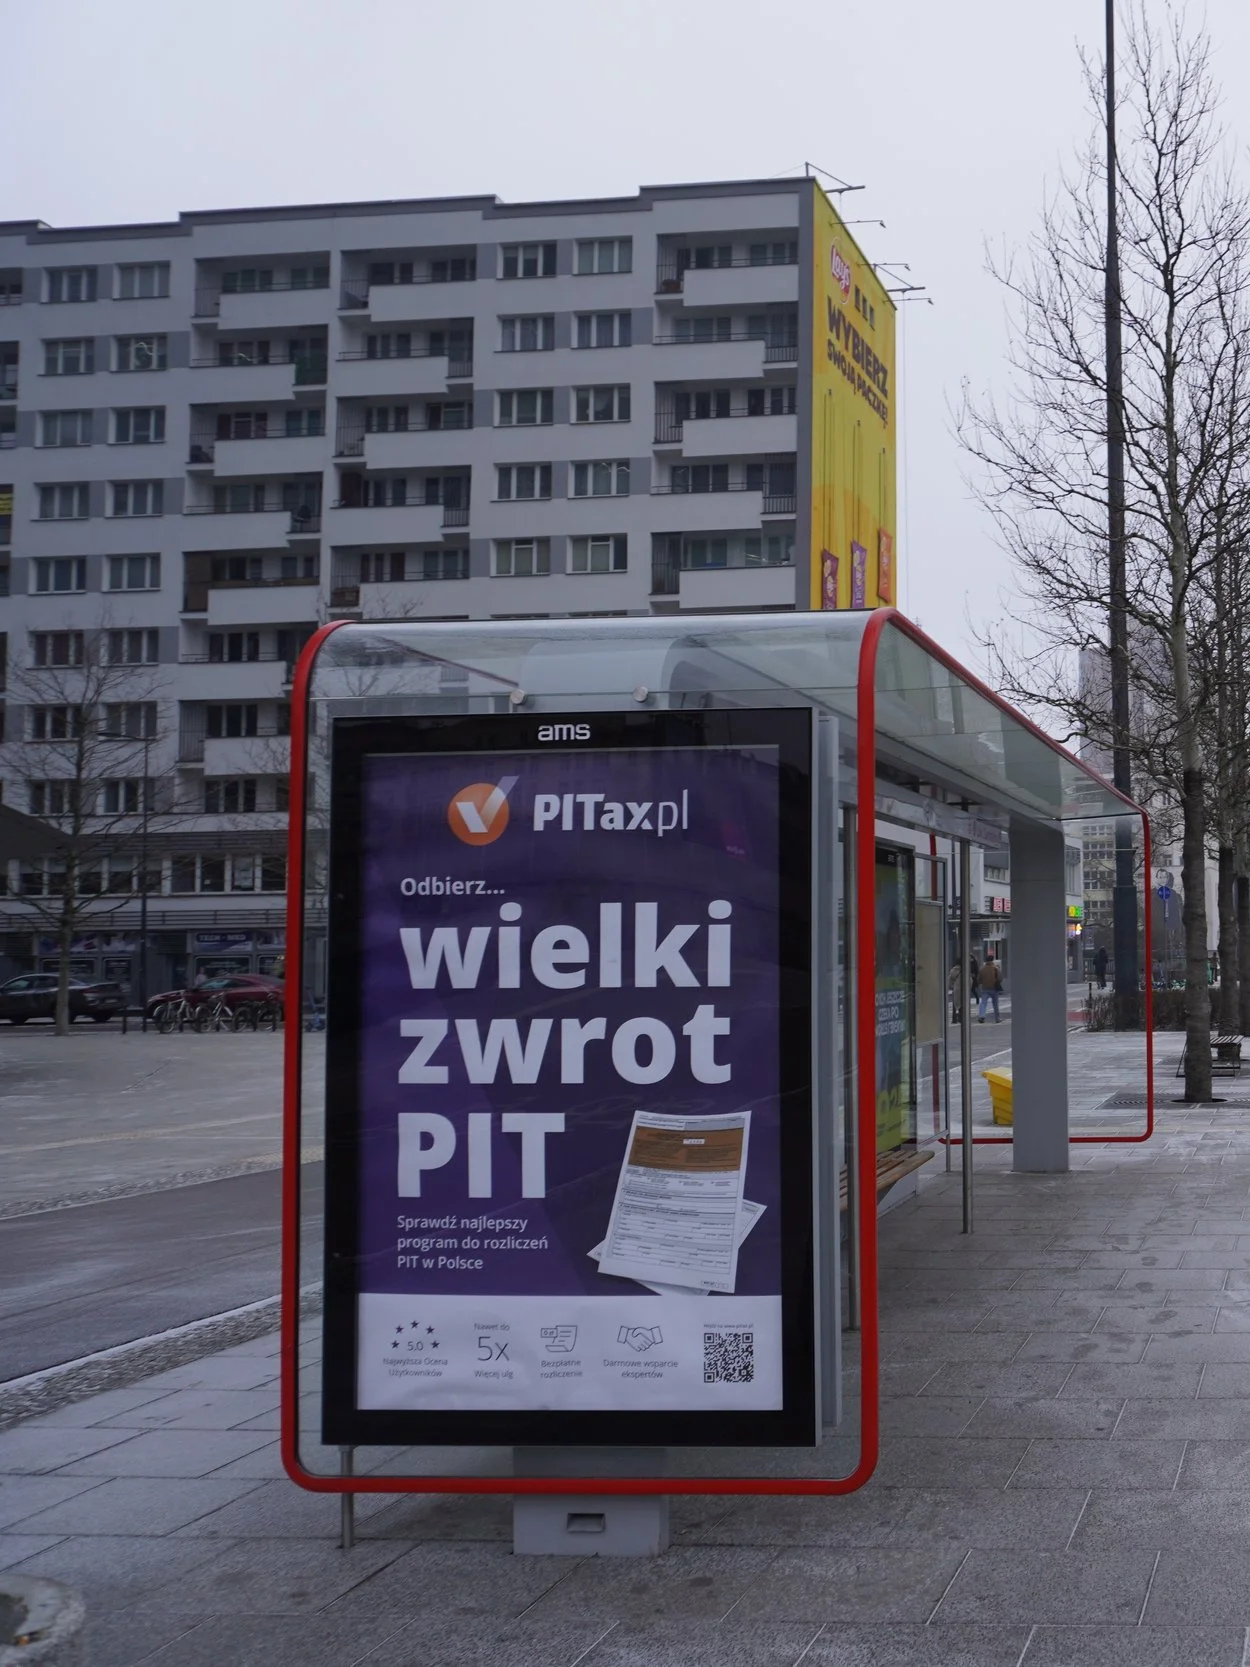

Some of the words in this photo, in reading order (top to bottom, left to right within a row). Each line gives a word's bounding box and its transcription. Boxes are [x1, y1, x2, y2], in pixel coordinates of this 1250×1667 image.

[827, 295, 888, 400] WYBIERZ
[537, 723, 591, 741] ams
[400, 876, 505, 896] Odbierz...
[399, 899, 733, 990] wielki
[398, 1004, 732, 1085] zwrot
[397, 1112, 566, 1199] PIT
[397, 1215, 457, 1231] Sprawdź
[460, 1215, 528, 1232] najlepszy
[397, 1237, 458, 1251] program
[461, 1235, 480, 1249] do
[484, 1235, 549, 1250] rozliczeń
[397, 1255, 420, 1269] PIT
[422, 1258, 434, 1269] w
[438, 1255, 484, 1270] Polsce
[478, 1336, 510, 1362] 5x
[423, 1357, 448, 1366] Ocena
[540, 1359, 581, 1369] Bezpłatne
[603, 1359, 642, 1368] Darmowe
[643, 1359, 679, 1369] wsparcie
[621, 1369, 664, 1379] ekspertów
